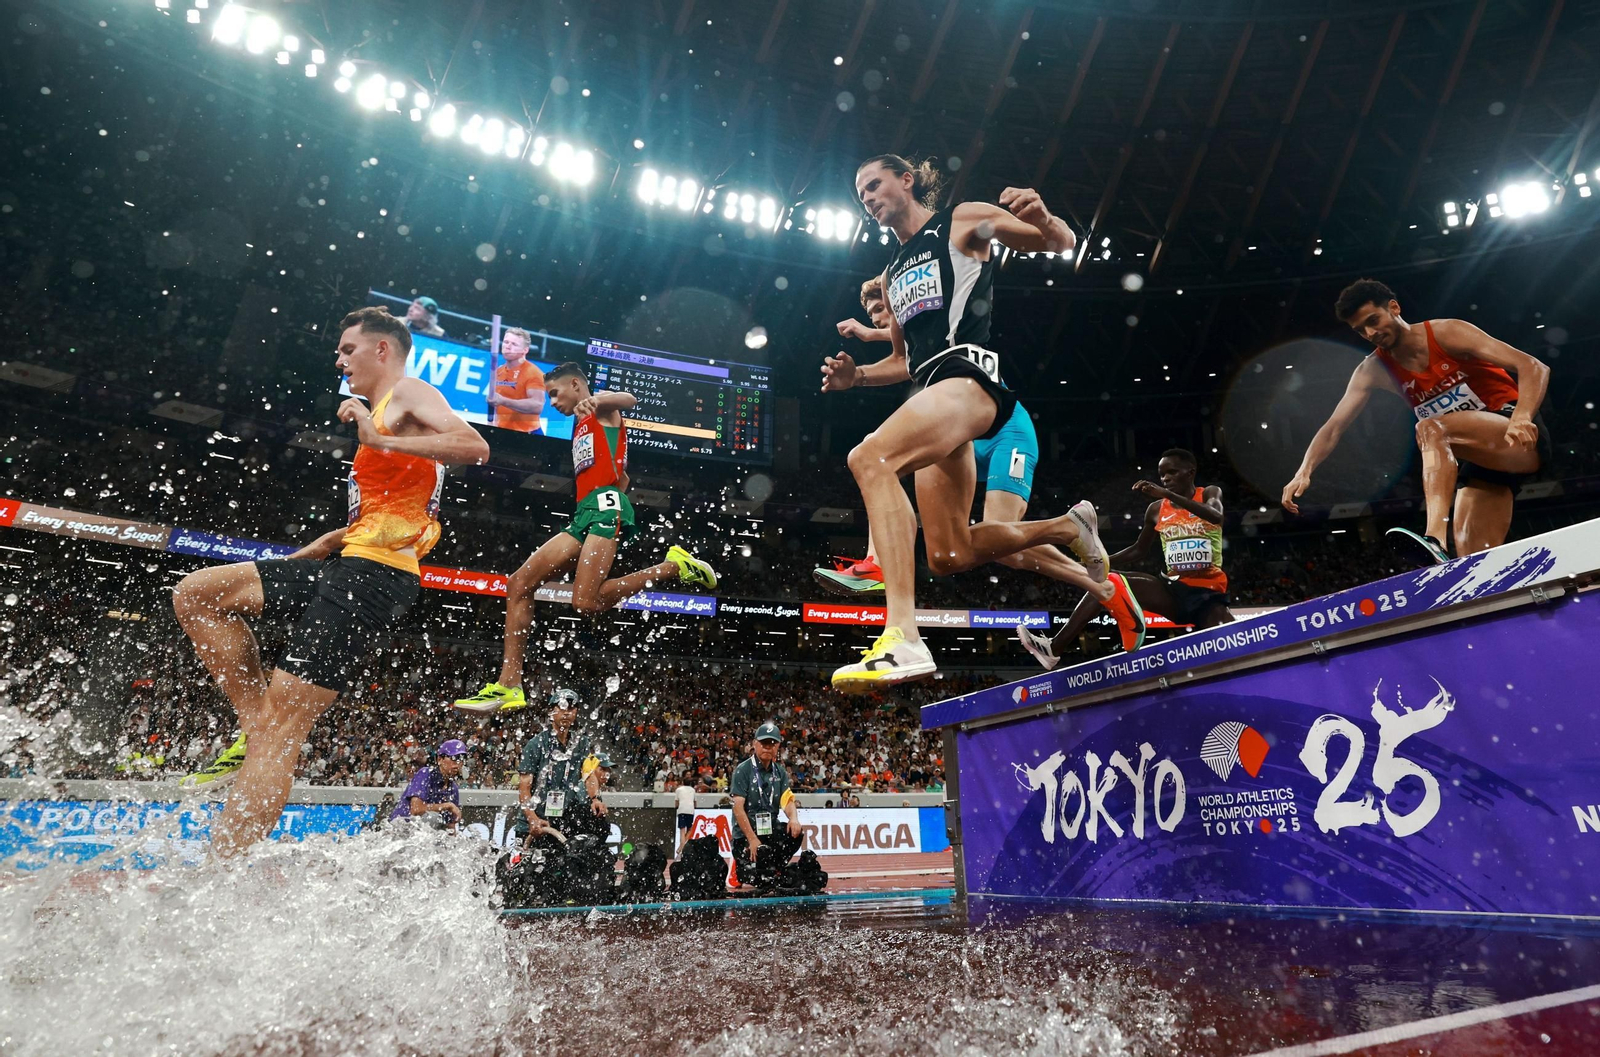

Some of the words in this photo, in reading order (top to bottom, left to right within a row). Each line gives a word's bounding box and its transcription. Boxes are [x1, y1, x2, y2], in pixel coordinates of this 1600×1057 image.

[903, 251, 932, 271] ZEALAND
[896, 263, 934, 291] TDK
[1413, 370, 1469, 402] UNISIA
[637, 396, 667, 407] ンドリクス
[1424, 385, 1468, 413] TDK
[605, 493, 616, 507] 5
[22, 510, 65, 529] Every
[66, 520, 118, 537] second,
[1162, 522, 1206, 539] KENYA
[174, 536, 211, 552] Every
[1177, 540, 1208, 550] TDK
[1168, 551, 1210, 563] KIBIWOT
[423, 572, 451, 586] Every
[536, 587, 555, 598] very
[1379, 589, 1408, 612] 25
[628, 597, 652, 607] Every
[653, 599, 685, 609] second,
[720, 604, 743, 614] Every
[744, 606, 774, 615] second,
[774, 605, 800, 618] Sugoi.
[807, 609, 829, 619] Every
[830, 611, 859, 620] second,
[859, 610, 885, 621] Sugoi.
[942, 613, 967, 624] Sugoi.
[973, 615, 994, 624] Every
[995, 616, 1022, 624] second,
[1022, 614, 1047, 625] Sugoi.
[1067, 669, 1102, 689] WORLD
[1106, 652, 1165, 680] ATHLETICS
[1167, 623, 1279, 664] CHAMPIONSHIPS
[1299, 674, 1455, 838] 25
[1011, 742, 1187, 844] TOKYO
[1198, 793, 1234, 807] WORLD
[1236, 787, 1294, 804] ATHLETICS
[1200, 801, 1298, 821] CHAMPIONSHIPS
[1571, 804, 1600, 833] N
[1276, 817, 1301, 832] 25
[801, 822, 916, 850] RINAGA
